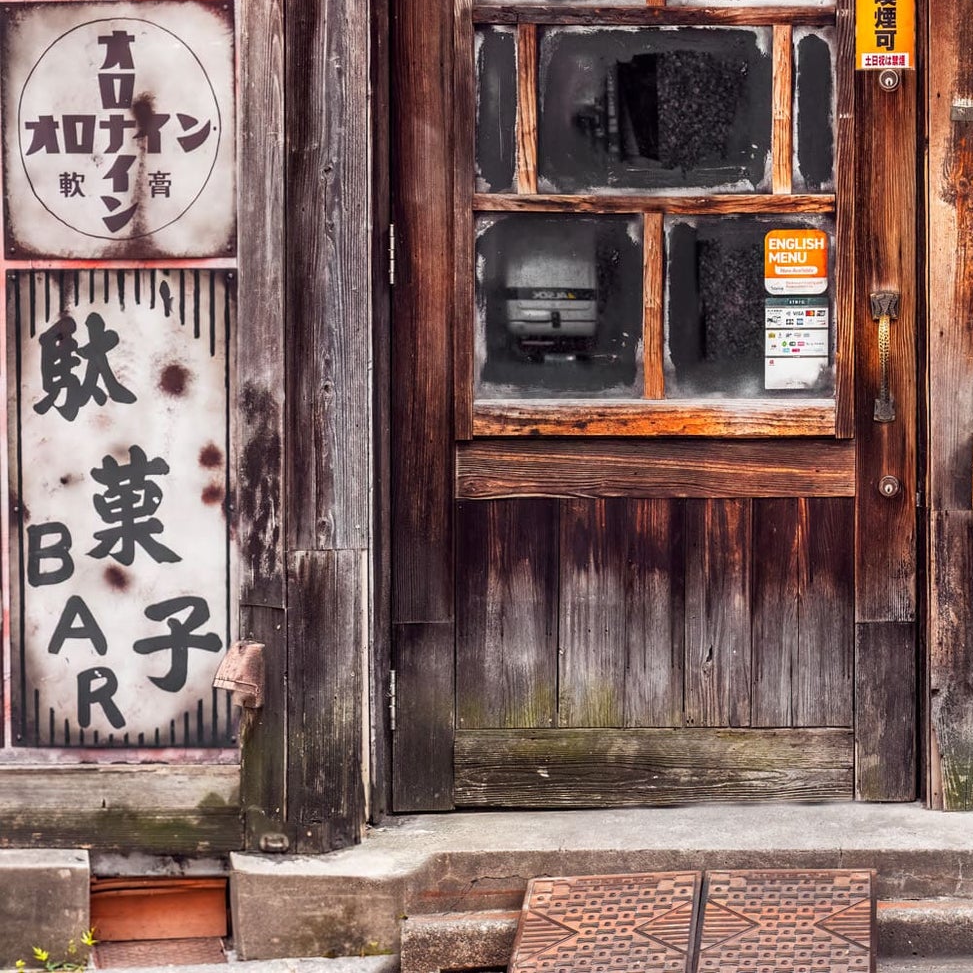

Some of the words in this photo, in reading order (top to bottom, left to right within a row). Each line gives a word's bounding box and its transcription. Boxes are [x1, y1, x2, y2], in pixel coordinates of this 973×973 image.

[865, 55, 905, 66] 土日祝は禁煙
[97, 30, 139, 233] オロナイン
[768, 237, 825, 250] ENGLISH
[768, 251, 807, 264] MENU
[33, 312, 223, 693] 駄菓子
[26, 521, 127, 729] BAR
